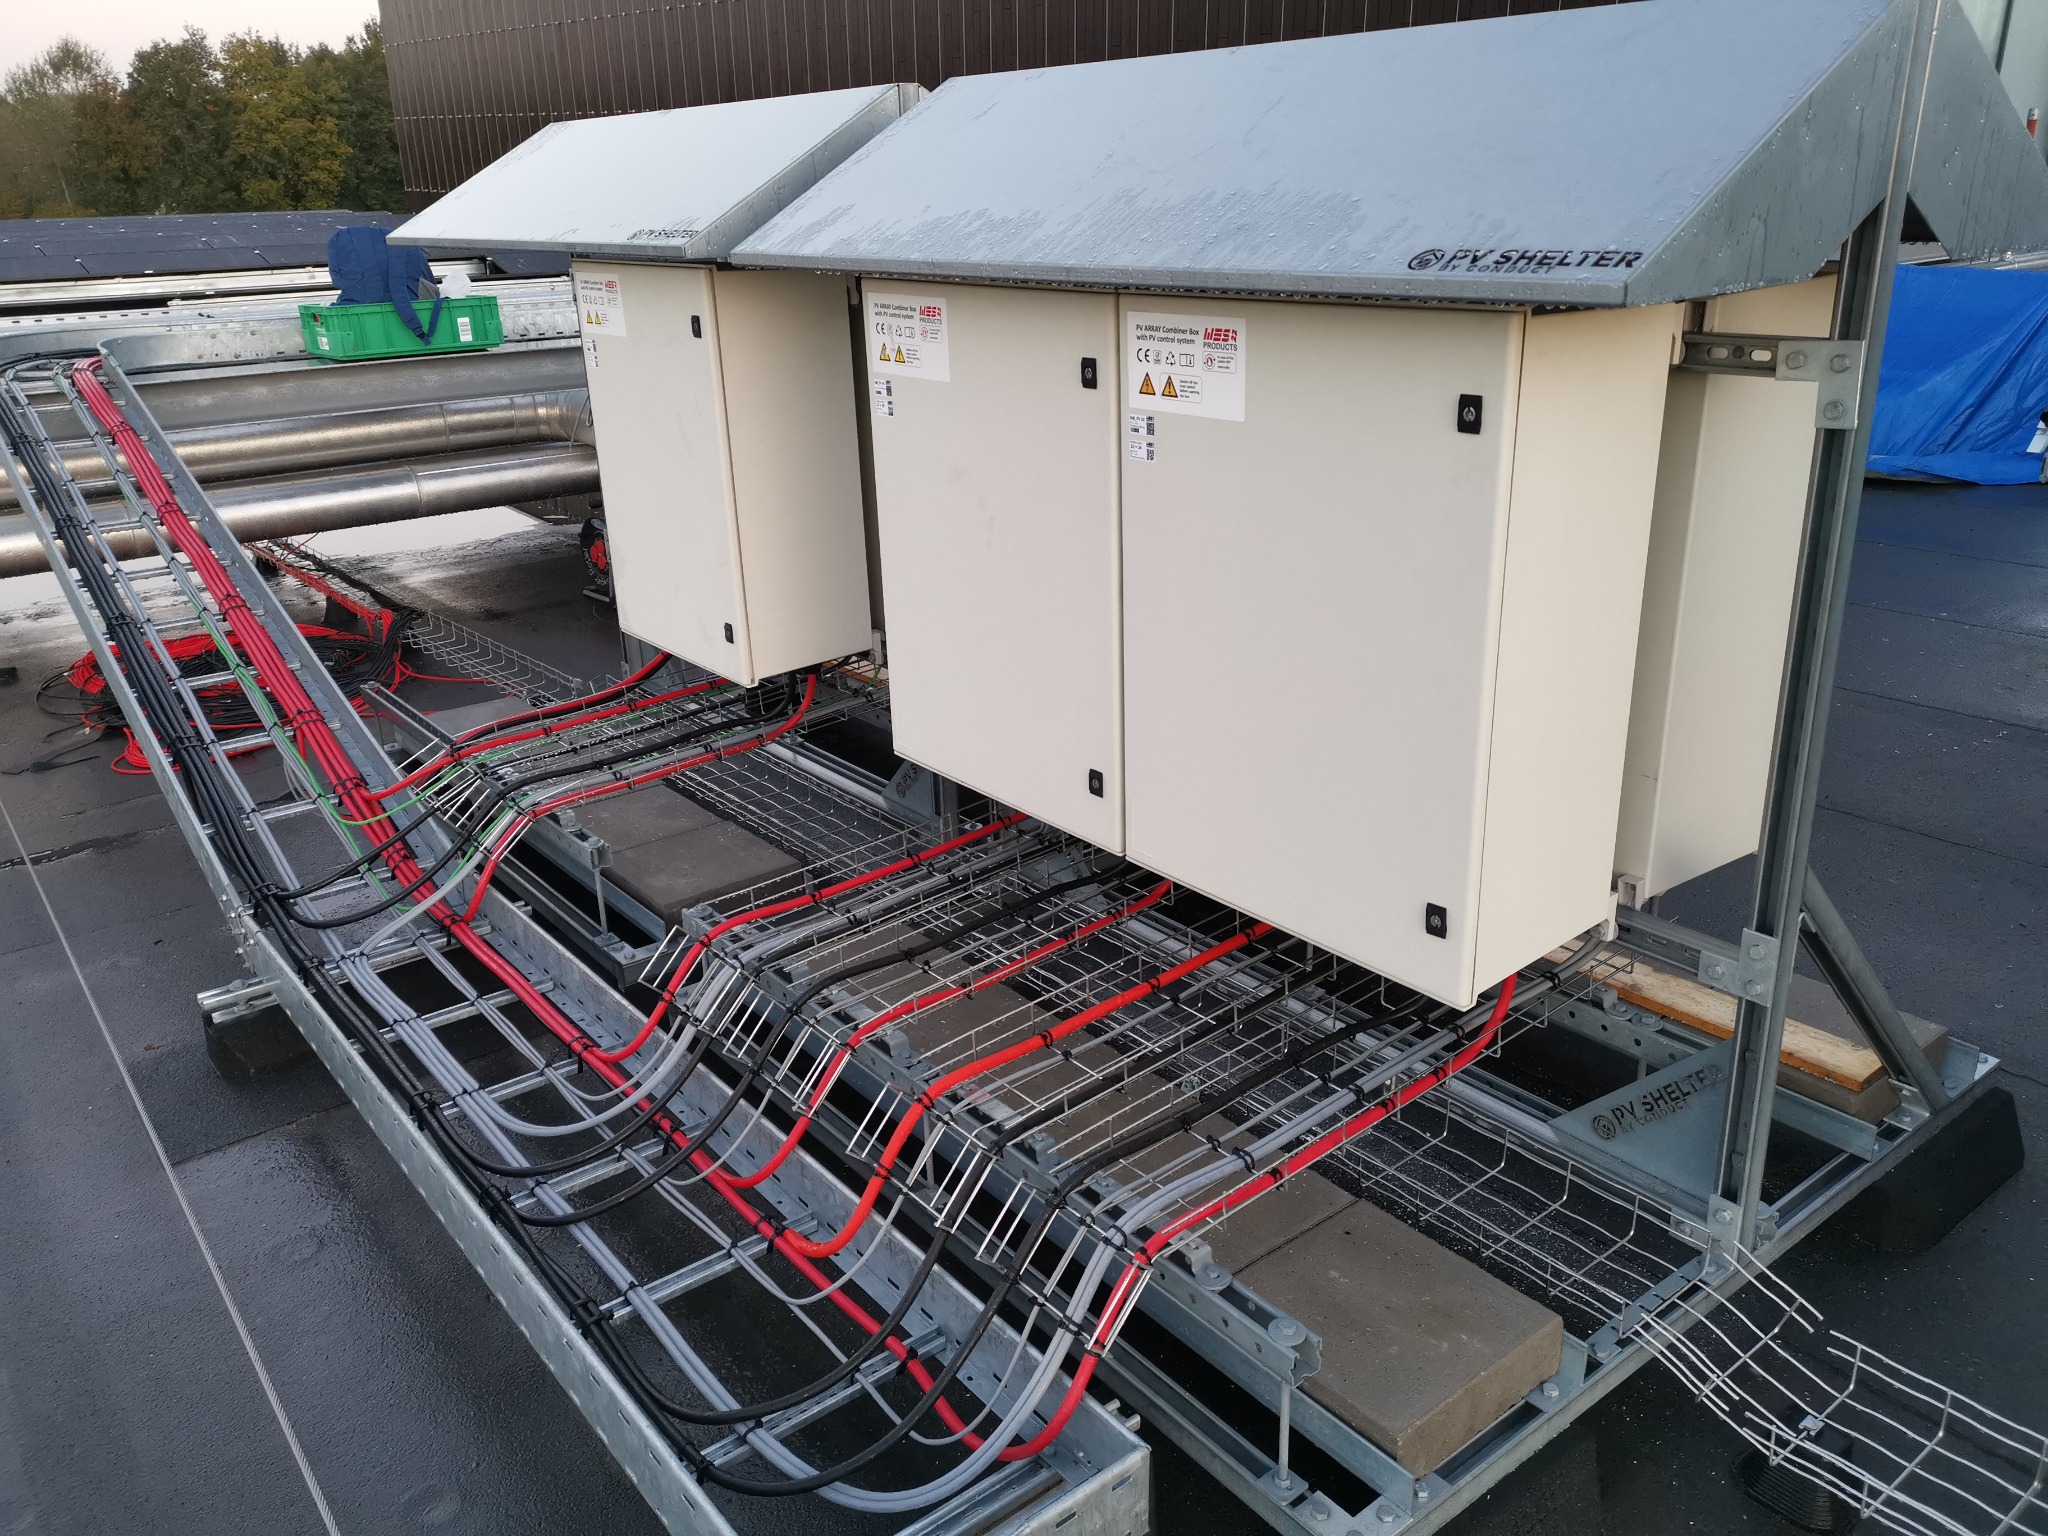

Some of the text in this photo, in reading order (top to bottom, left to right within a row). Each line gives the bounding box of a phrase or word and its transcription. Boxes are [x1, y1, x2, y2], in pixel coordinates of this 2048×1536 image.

[1448, 249, 1643, 268] PV SHELTER
[1438, 263, 1556, 274] BY CONDUCT
[919, 317, 943, 325] PRODUCTS
[1136, 324, 1199, 336] PV ARRAY Combiner Box
[1157, 335, 1175, 343] control
[1176, 337, 1195, 345] system
[1203, 341, 1238, 351] PRODUCTS
[1611, 1100, 1637, 1125] PV
